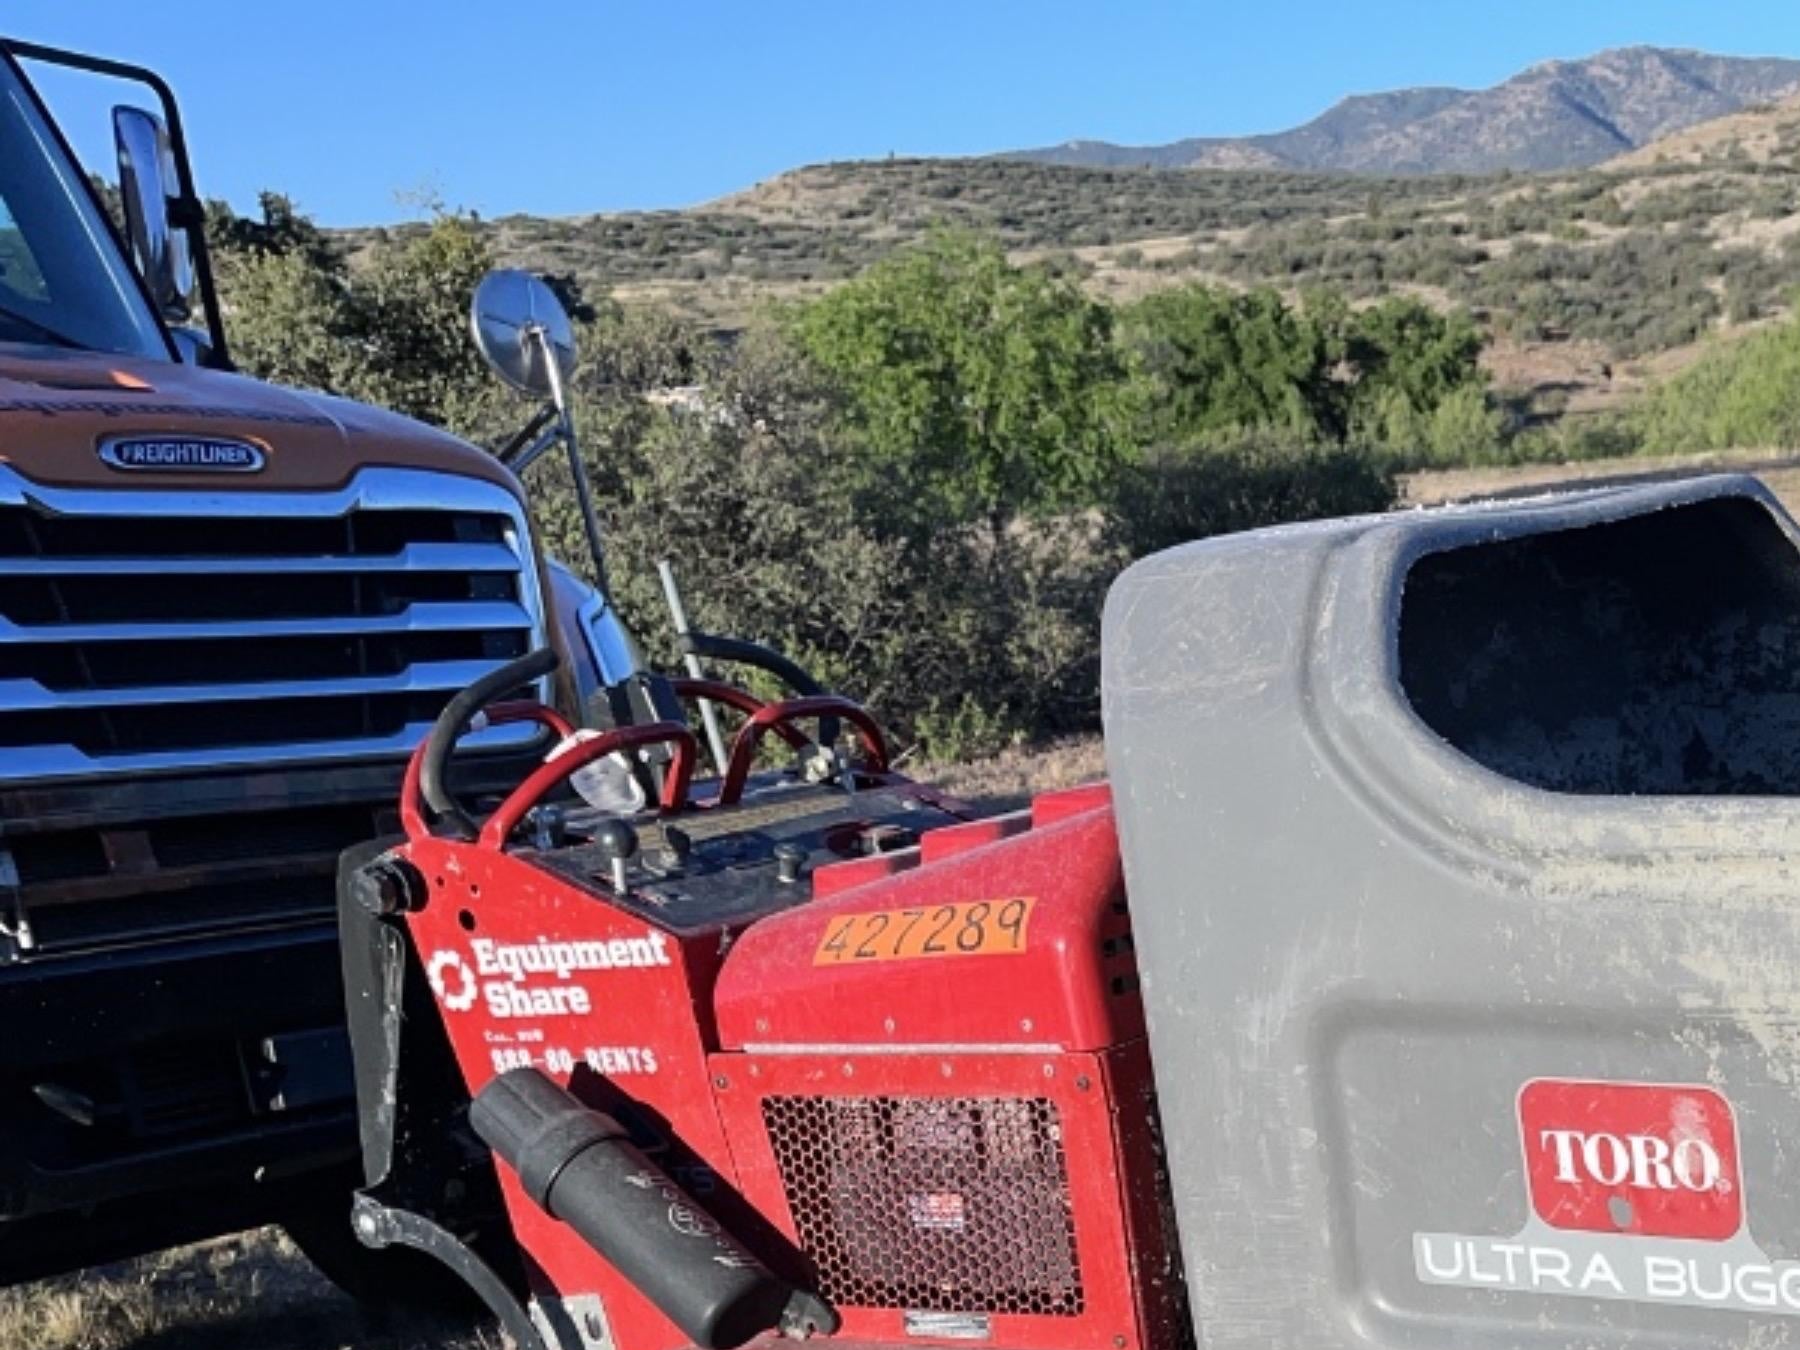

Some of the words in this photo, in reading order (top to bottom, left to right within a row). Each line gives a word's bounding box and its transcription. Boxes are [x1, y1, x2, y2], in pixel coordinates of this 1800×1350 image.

[122, 443, 250, 464] FREIGHTLINER
[470, 929, 671, 981] Equipment
[822, 899, 1027, 961] 427289
[484, 980, 591, 1018] Share
[1540, 1129, 1721, 1192] TORO
[1421, 1237, 1624, 1293] ULTRA
